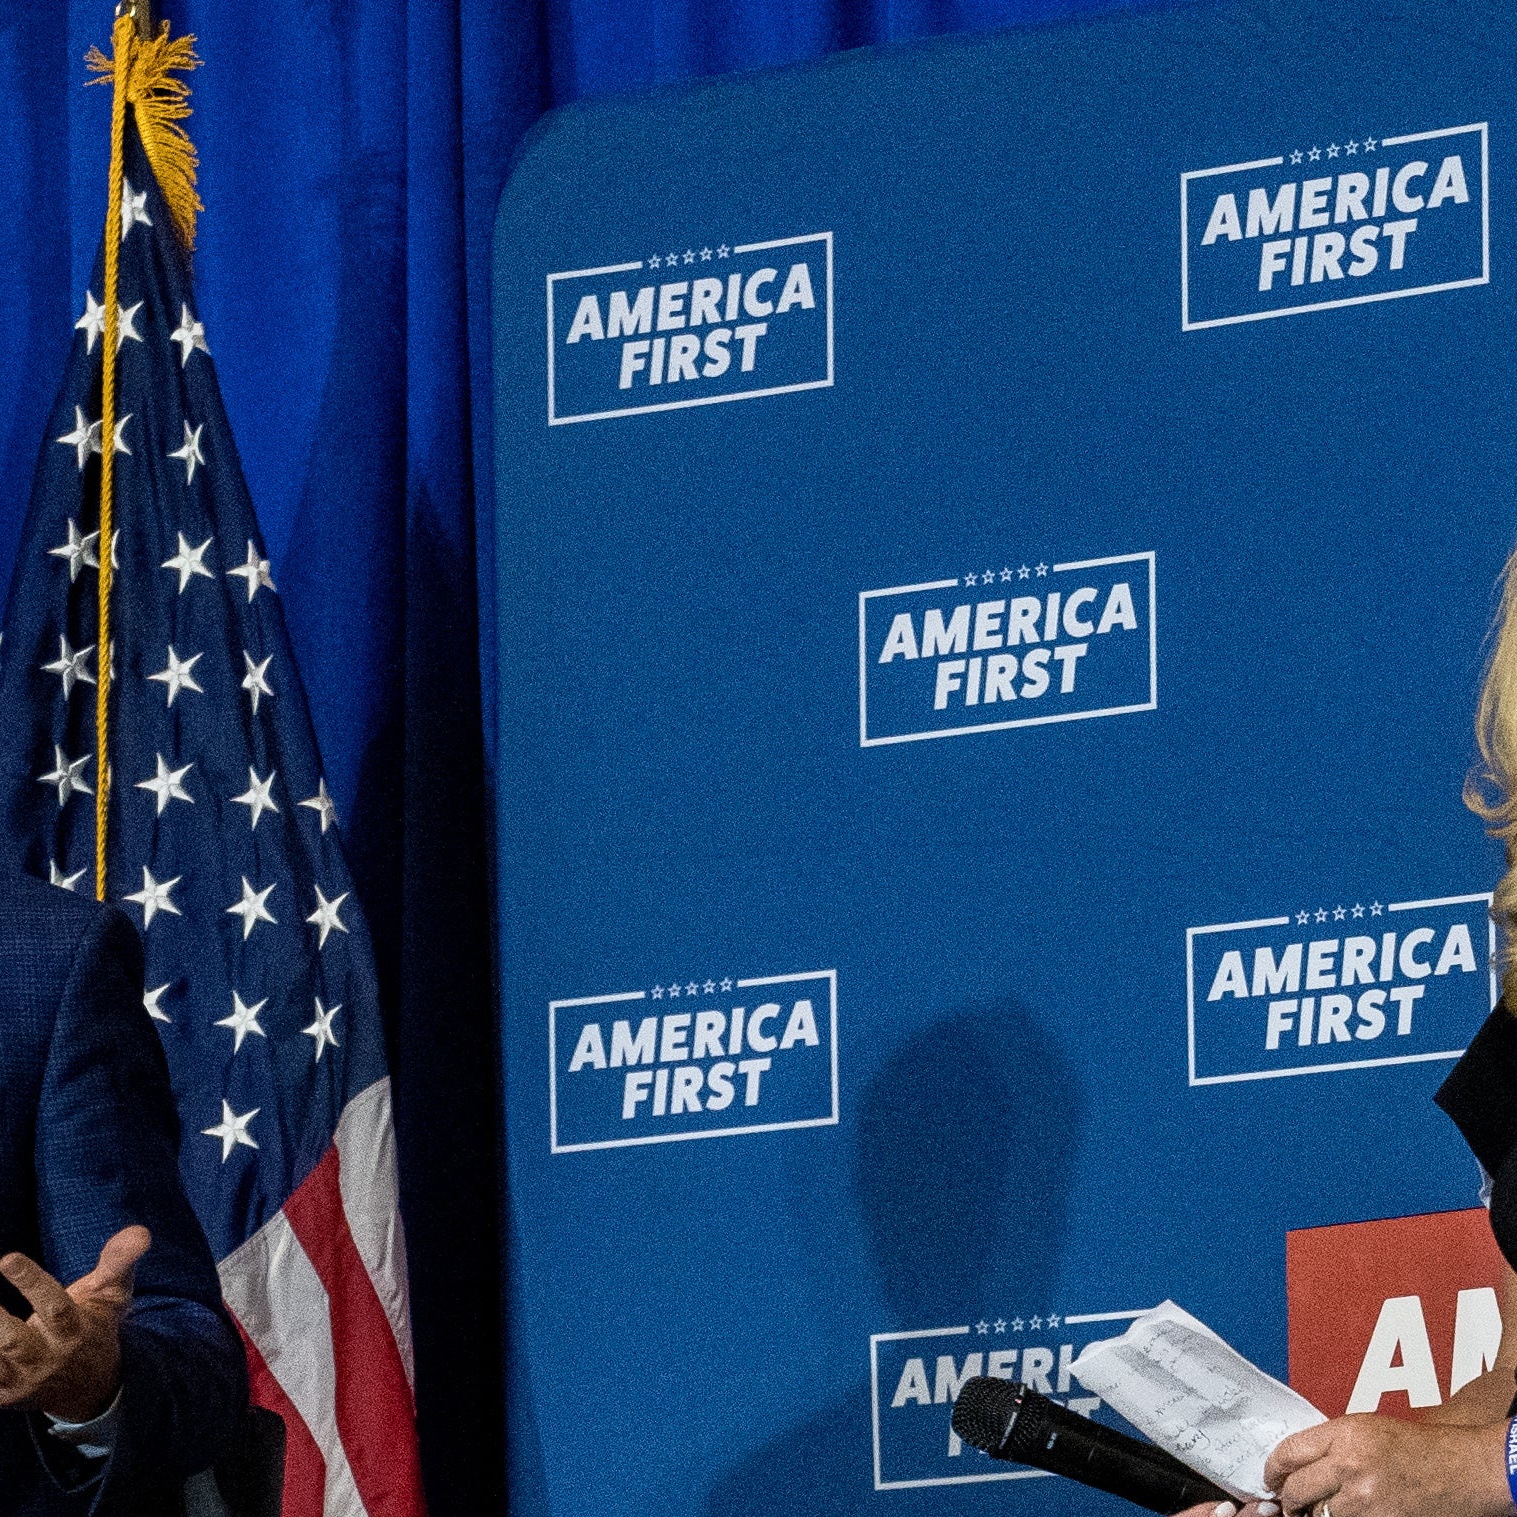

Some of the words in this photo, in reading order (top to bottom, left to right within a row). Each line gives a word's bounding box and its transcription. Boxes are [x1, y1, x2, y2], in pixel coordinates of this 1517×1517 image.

[1201, 155, 1470, 246] AMERICA
[1258, 218, 1418, 292] FIRST
[566, 262, 816, 344] AMERICA
[619, 322, 768, 390] FIRST
[878, 582, 1138, 664] AMERICA
[934, 643, 1088, 710] FIRST
[1207, 923, 1477, 1002] AMERICA
[569, 999, 820, 1072] AMERICA
[1265, 984, 1425, 1050] FIRST
[622, 1057, 772, 1119] FIRST
